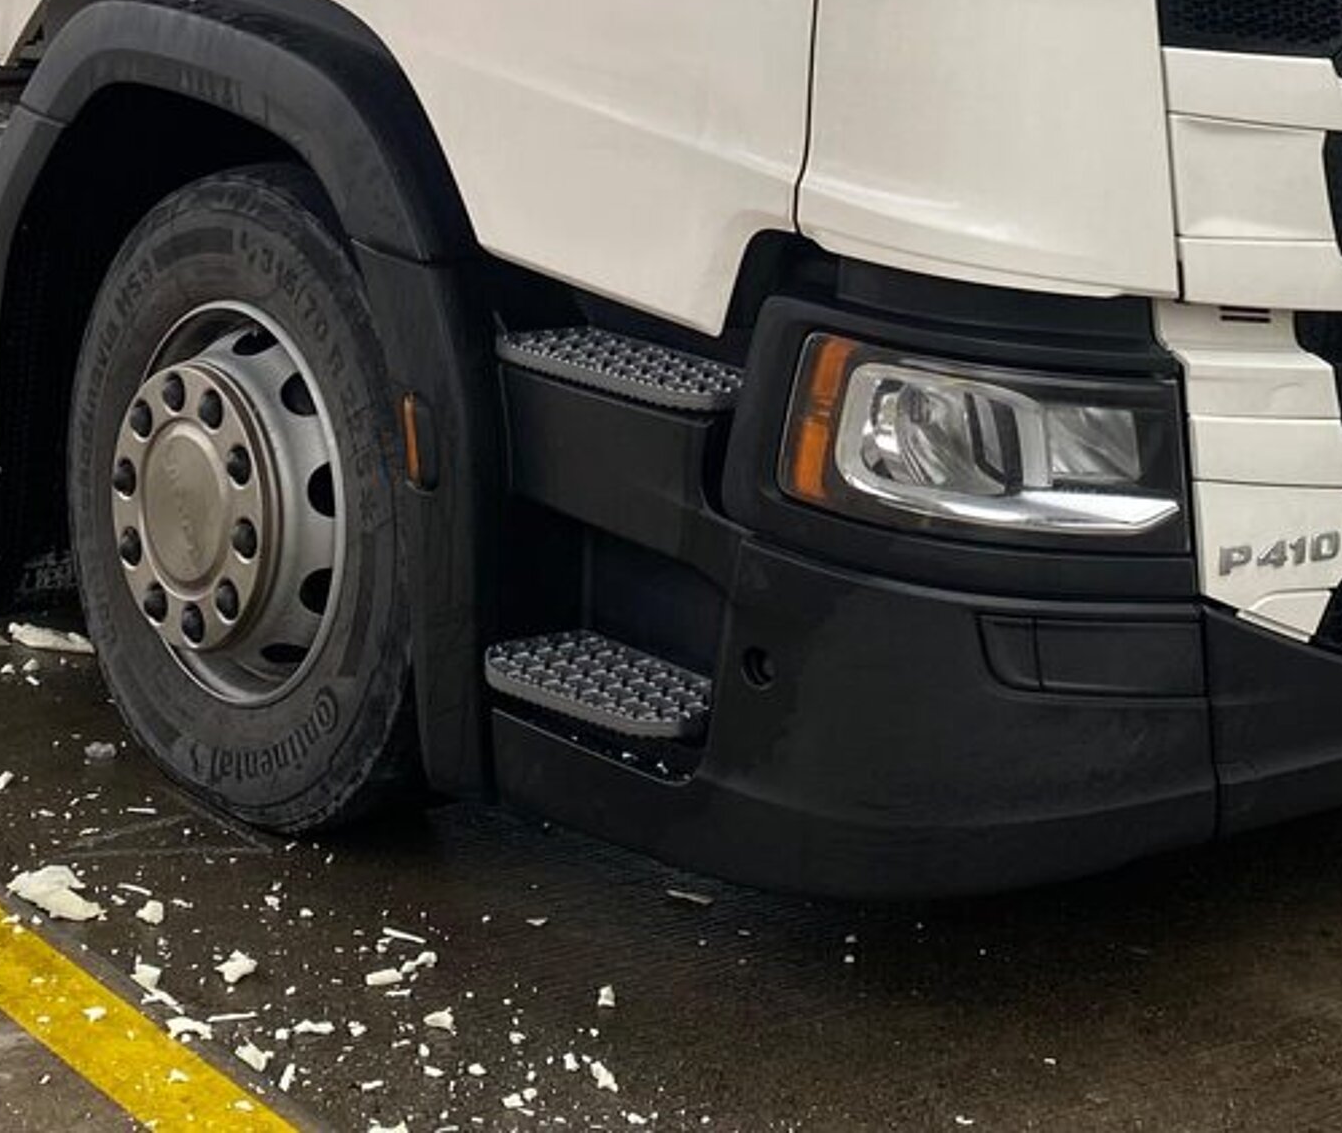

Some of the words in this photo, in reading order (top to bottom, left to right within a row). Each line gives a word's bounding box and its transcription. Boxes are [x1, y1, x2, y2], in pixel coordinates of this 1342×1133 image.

[1219, 545, 1252, 576] P
[1257, 531, 1341, 569] 410
[210, 685, 339, 784] Continental
